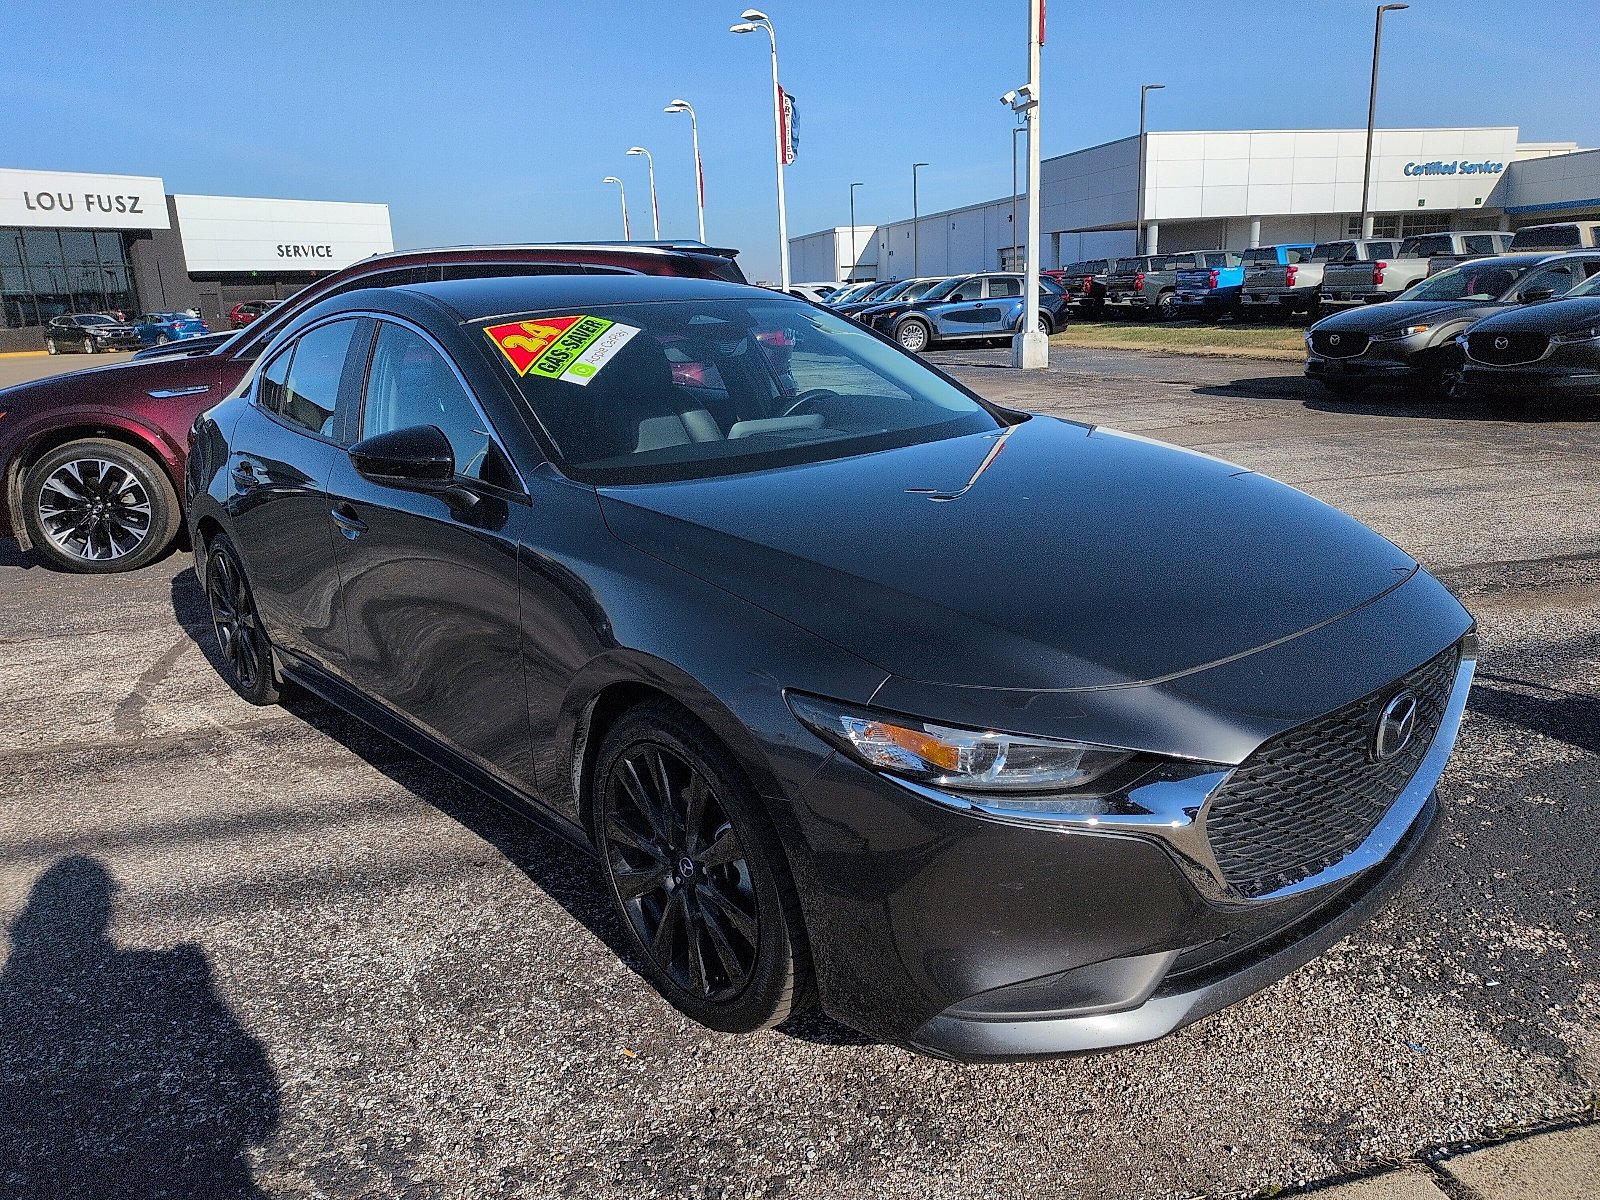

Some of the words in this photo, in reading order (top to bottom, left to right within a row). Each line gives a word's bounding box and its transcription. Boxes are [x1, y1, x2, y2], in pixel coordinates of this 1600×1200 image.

[1403, 160, 1457, 176] Certified
[1458, 160, 1503, 175] Service
[23, 191, 74, 211] LOU
[84, 194, 143, 214] FUSZ
[276, 244, 333, 258] SERVICE
[501, 322, 562, 353] 24
[537, 318, 603, 374] GAS-SAVER
